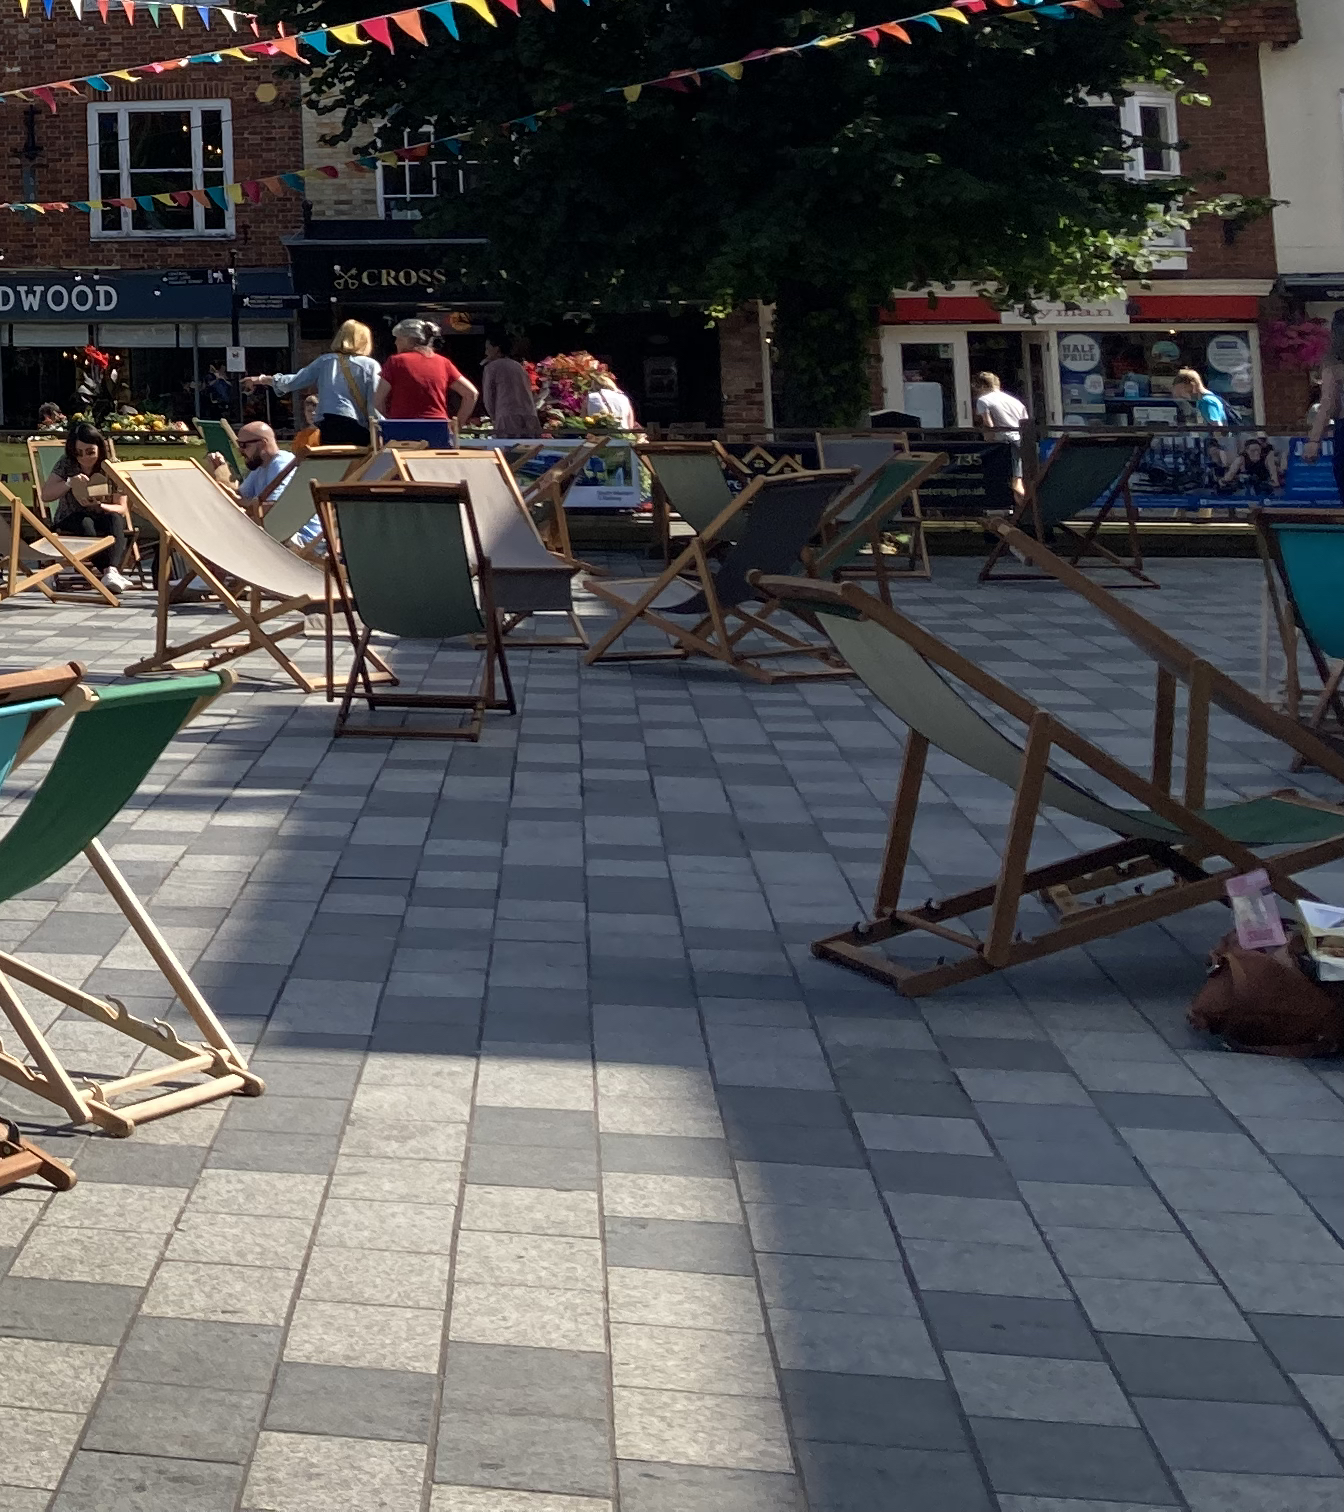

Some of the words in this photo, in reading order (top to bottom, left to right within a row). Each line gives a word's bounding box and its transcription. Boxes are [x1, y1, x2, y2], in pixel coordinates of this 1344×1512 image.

[362, 268, 446, 286] CROSS
[1016, 307, 1113, 319] yman
[1062, 344, 1095, 353] HALF
[954, 454, 982, 466] 735
